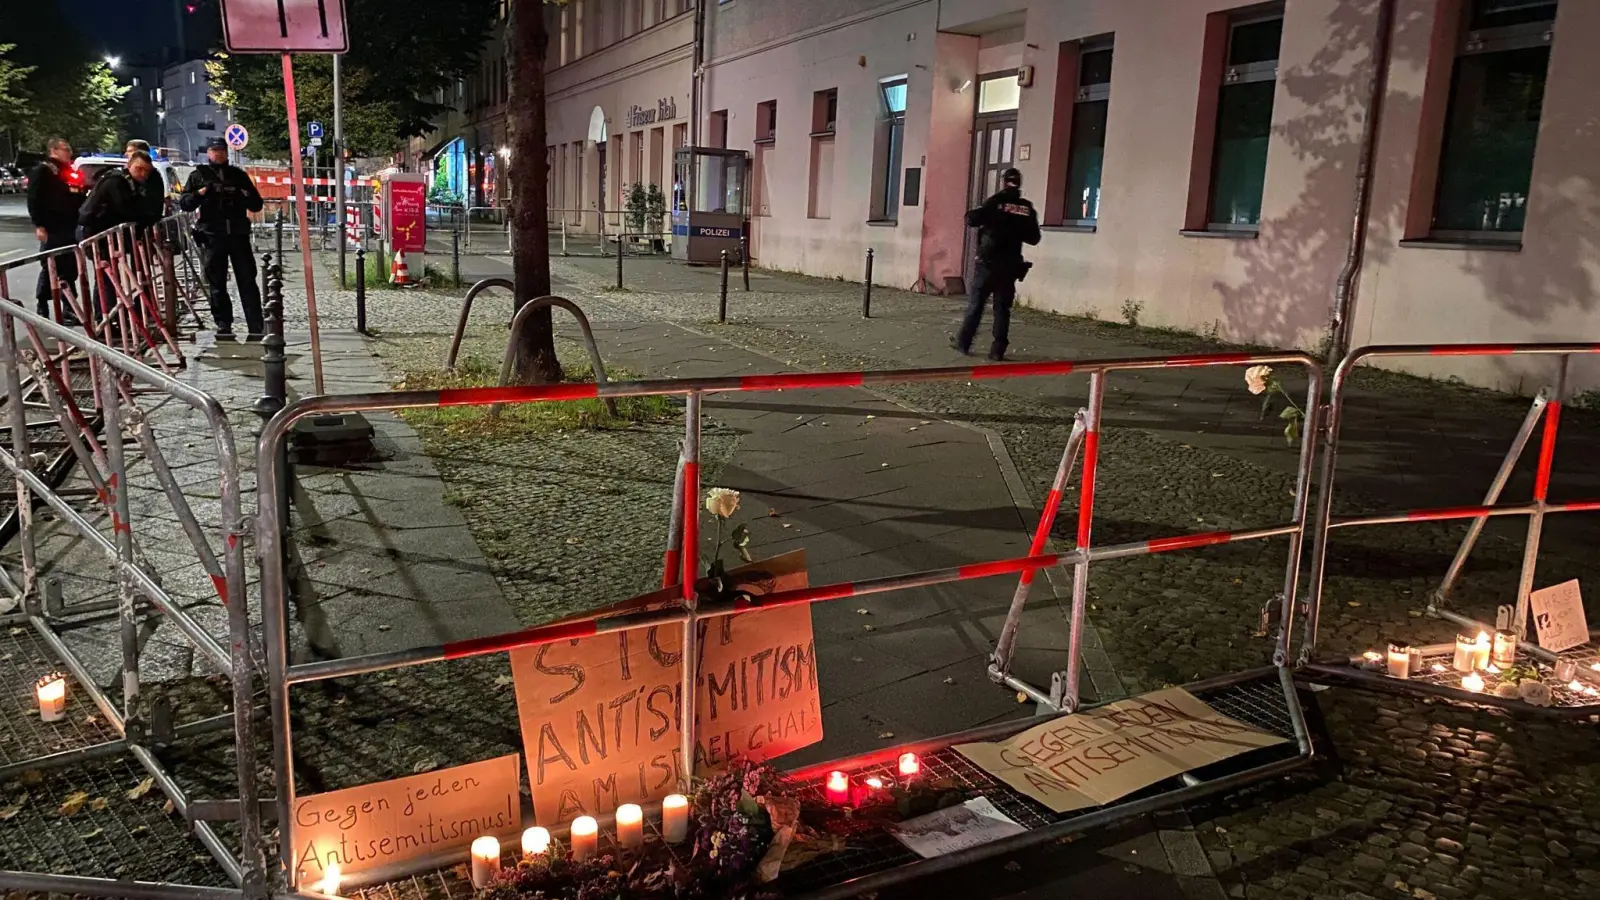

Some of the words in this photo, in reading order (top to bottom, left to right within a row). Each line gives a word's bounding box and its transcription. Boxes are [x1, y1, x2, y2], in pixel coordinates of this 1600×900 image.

[310, 124, 320, 136] P
[633, 105, 656, 127] Friseur
[700, 228, 730, 237] POLIZEI
[1000, 720, 1106, 768] GEGEN
[1098, 699, 1188, 731] JEDEN
[1023, 717, 1248, 796] ANTISEMITISMUS
[296, 796, 391, 830] Gegen
[403, 775, 481, 817] jeden
[558, 772, 620, 824] AM
[297, 793, 514, 871] Antisemitismus!
